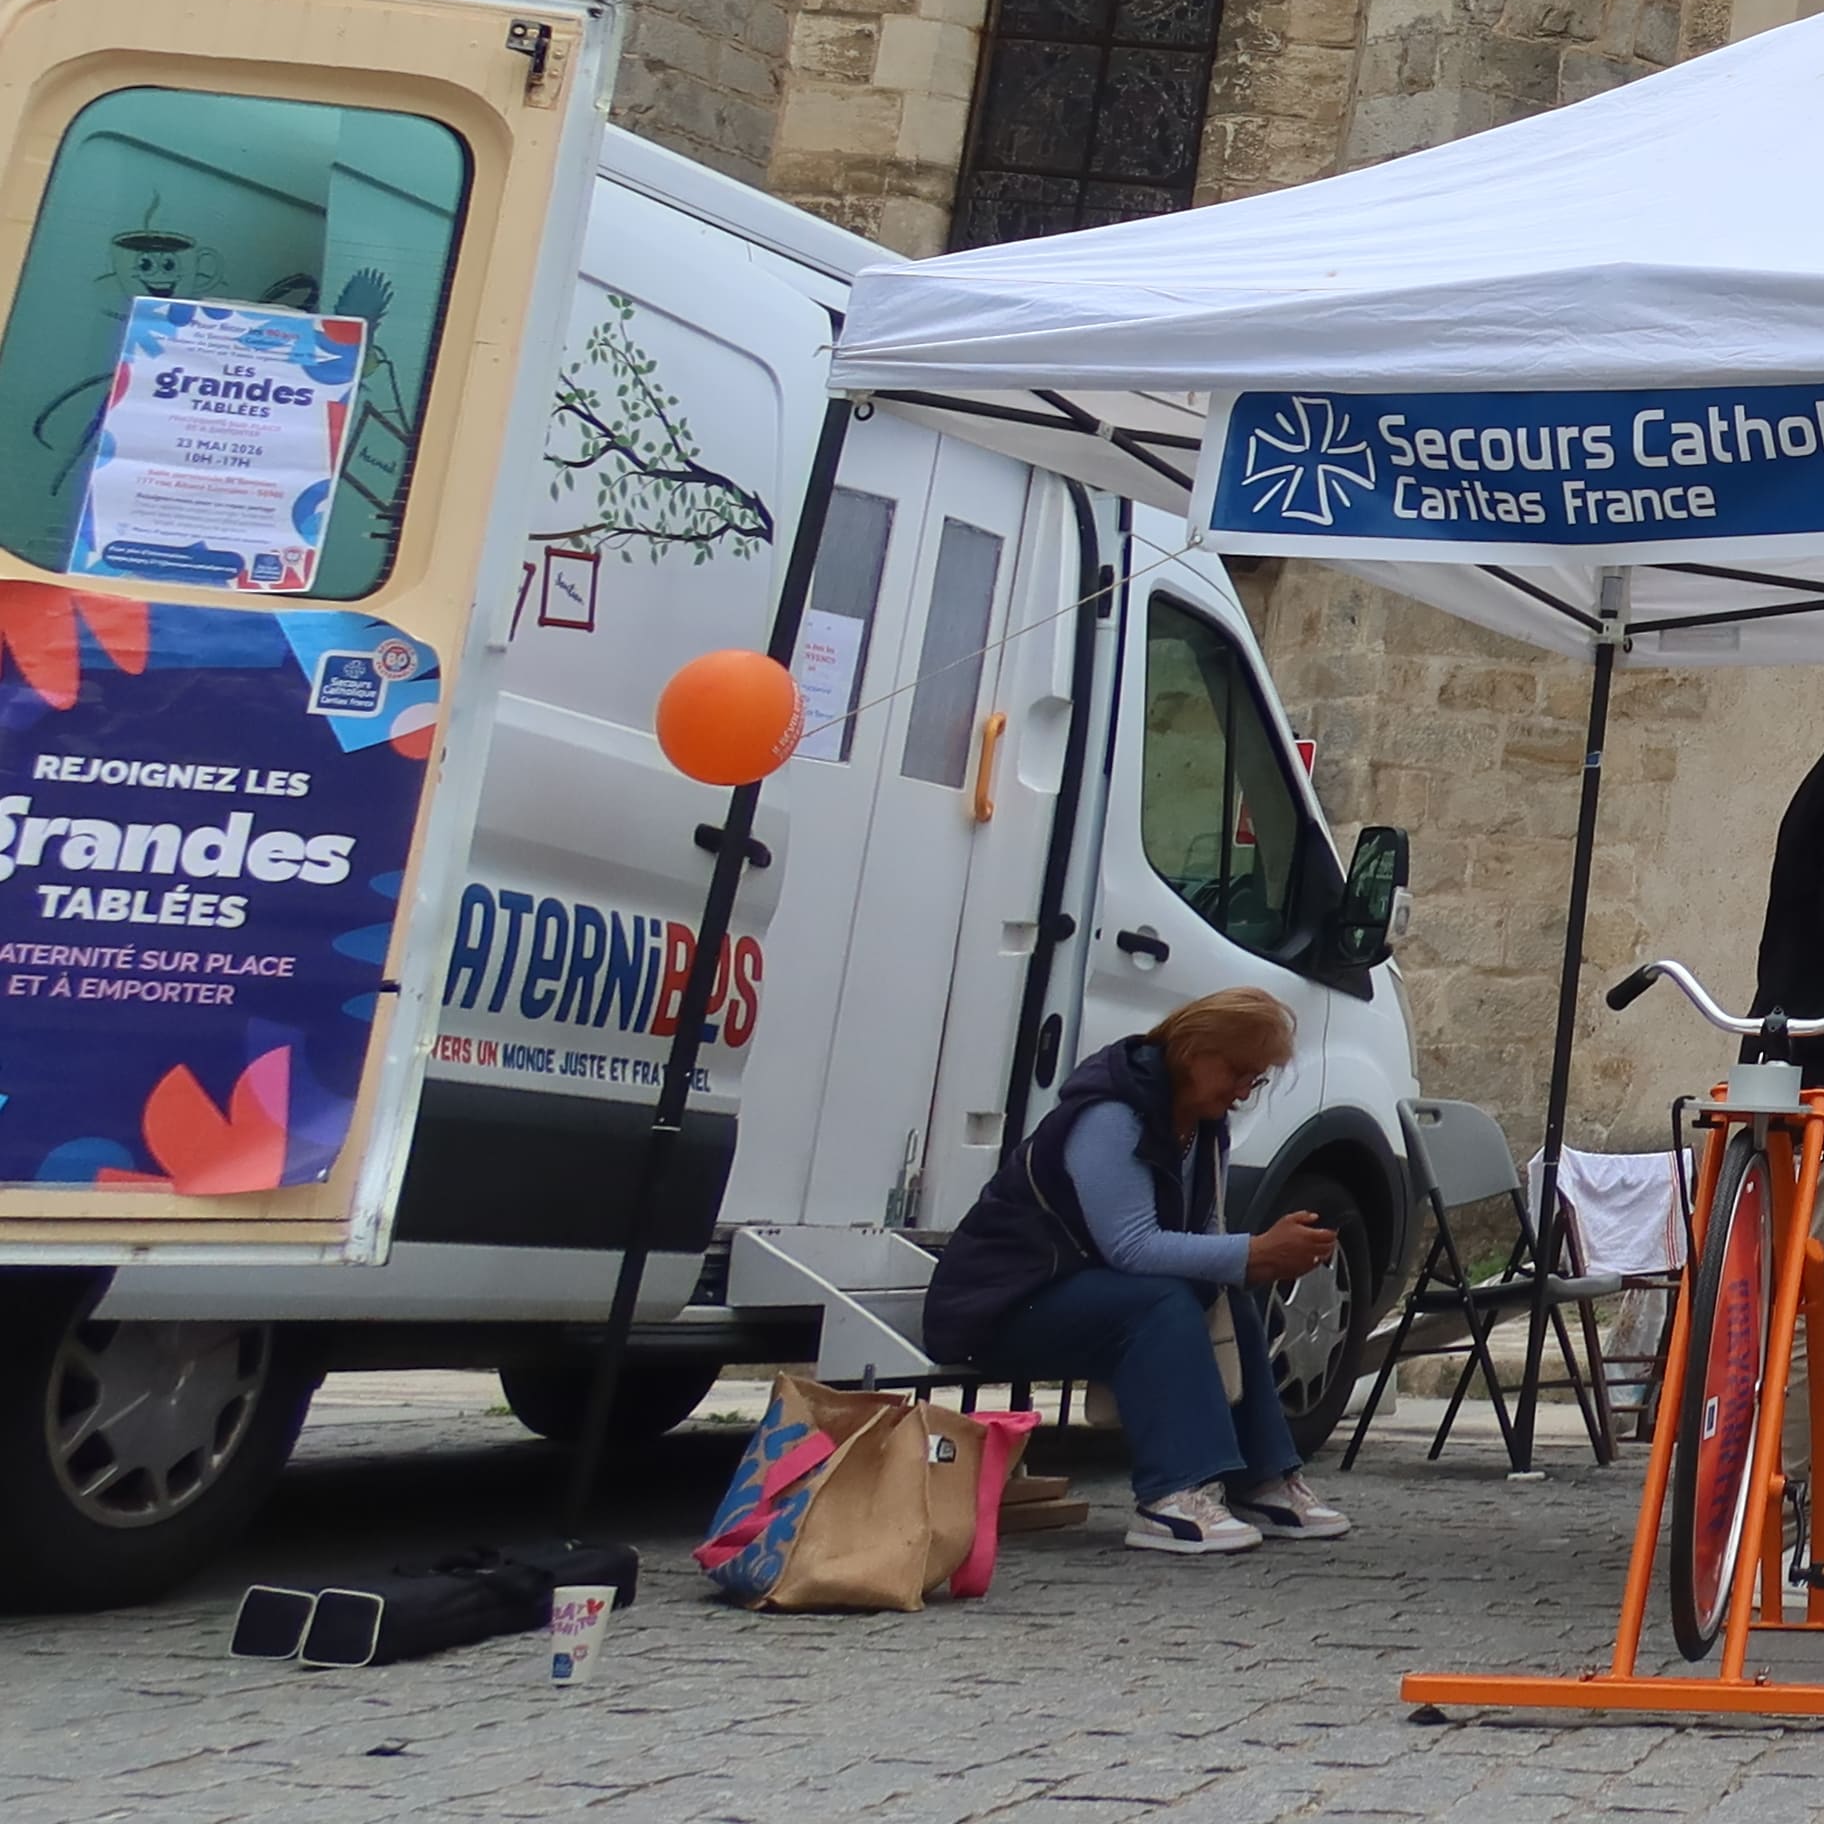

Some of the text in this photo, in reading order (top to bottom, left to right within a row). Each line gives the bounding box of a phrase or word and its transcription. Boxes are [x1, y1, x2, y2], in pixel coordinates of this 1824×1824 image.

[153, 366, 314, 406] grandes
[223, 364, 256, 378] LES
[191, 398, 271, 418] TABLÉES
[176, 437, 264, 456] 23 MAI 2026
[1378, 414, 1615, 471] Secours
[1393, 476, 1717, 525] Caritas France
[330, 677, 373, 689] Secours
[33, 754, 311, 798] REJOIGNEZ LES
[37, 883, 249, 929] TABLÉES
[139, 949, 200, 973] SUR
[203, 953, 296, 977] PLACE
[8, 971, 235, 1005] ET À EMPORTER
[477, 1041, 498, 1067] UN
[502, 1044, 555, 1074] MONDE
[559, 1051, 605, 1079] JUSTE
[609, 1059, 628, 1083] ET
